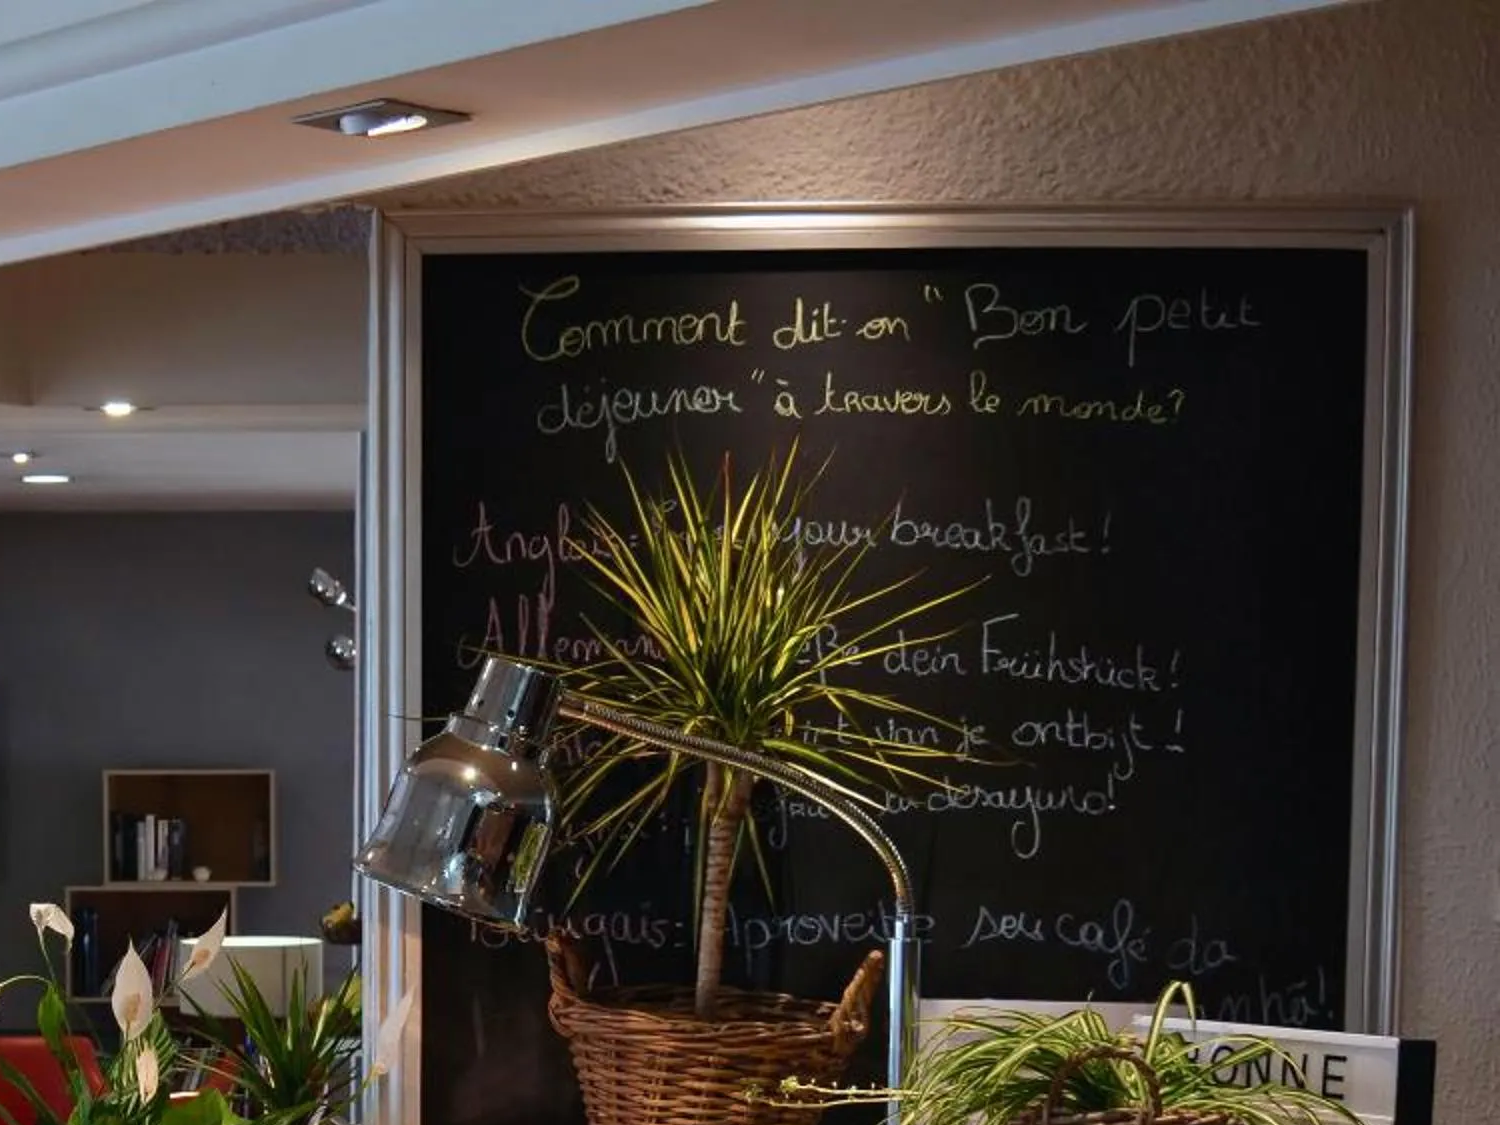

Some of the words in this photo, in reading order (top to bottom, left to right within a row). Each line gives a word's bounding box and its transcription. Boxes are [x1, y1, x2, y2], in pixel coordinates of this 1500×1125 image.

[517, 273, 747, 362] Comment
[1112, 292, 1263, 368] petit
[773, 378, 804, 419] à
[812, 370, 952, 416] travers
[969, 369, 1002, 414] le
[1015, 387, 1187, 426] monde?
[883, 628, 968, 677] dein
[1166, 913, 1240, 976] da
[1188, 1043, 1348, 1101] ONNE
